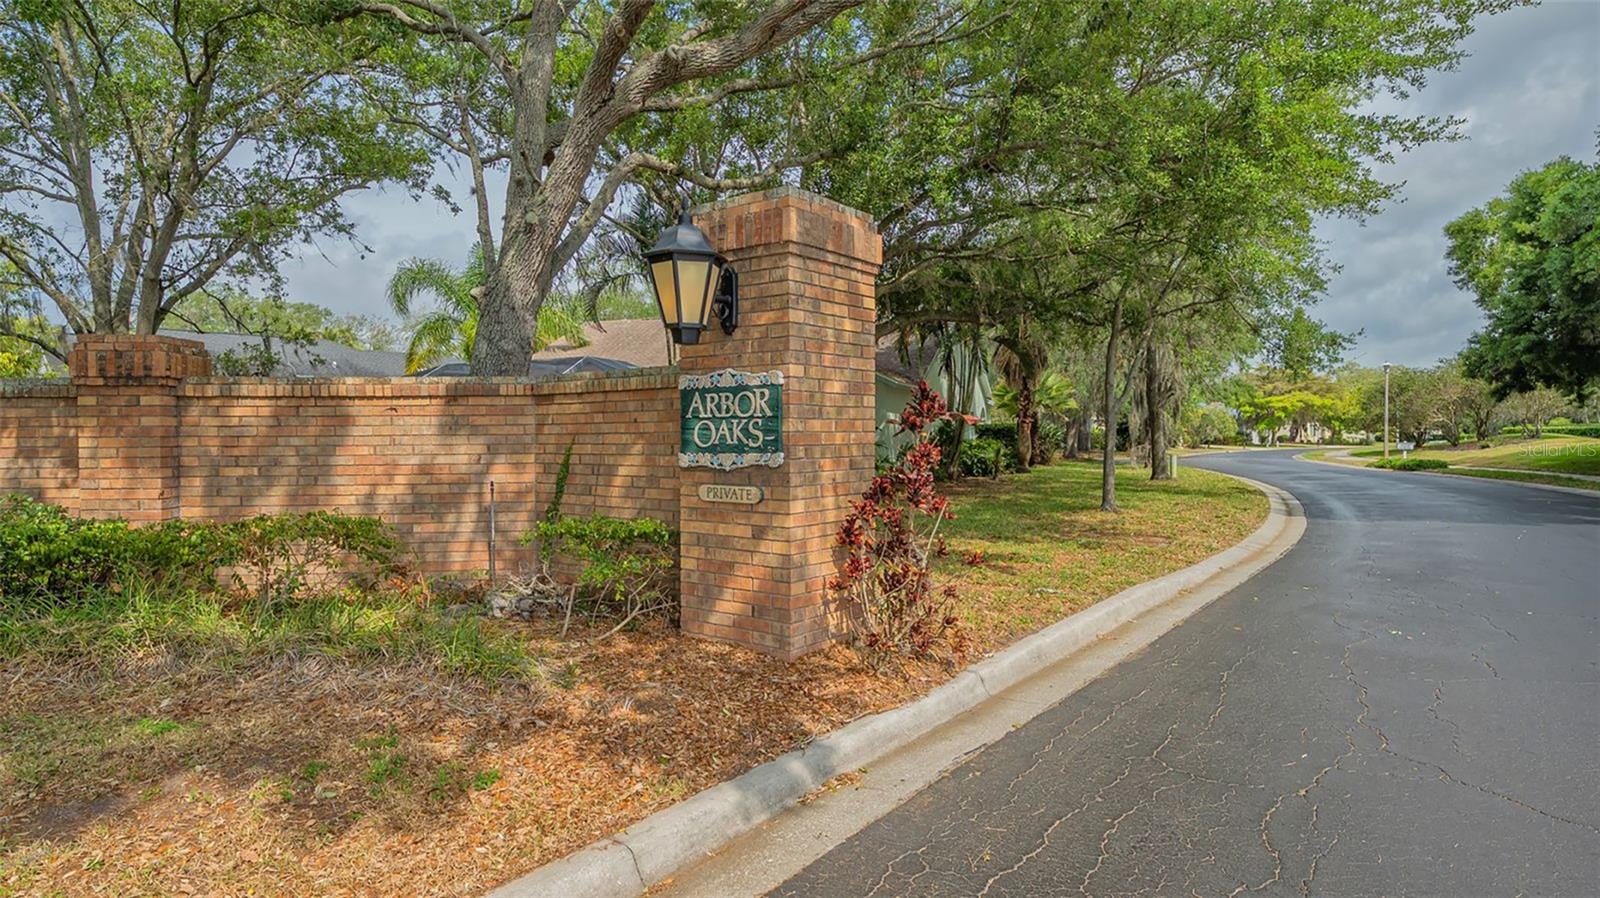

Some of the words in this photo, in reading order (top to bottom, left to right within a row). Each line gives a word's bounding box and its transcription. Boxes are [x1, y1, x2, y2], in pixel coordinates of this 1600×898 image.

[686, 389, 772, 418] ARBOR
[693, 419, 763, 447] OAKS
[706, 487, 752, 500] PRIVATE
